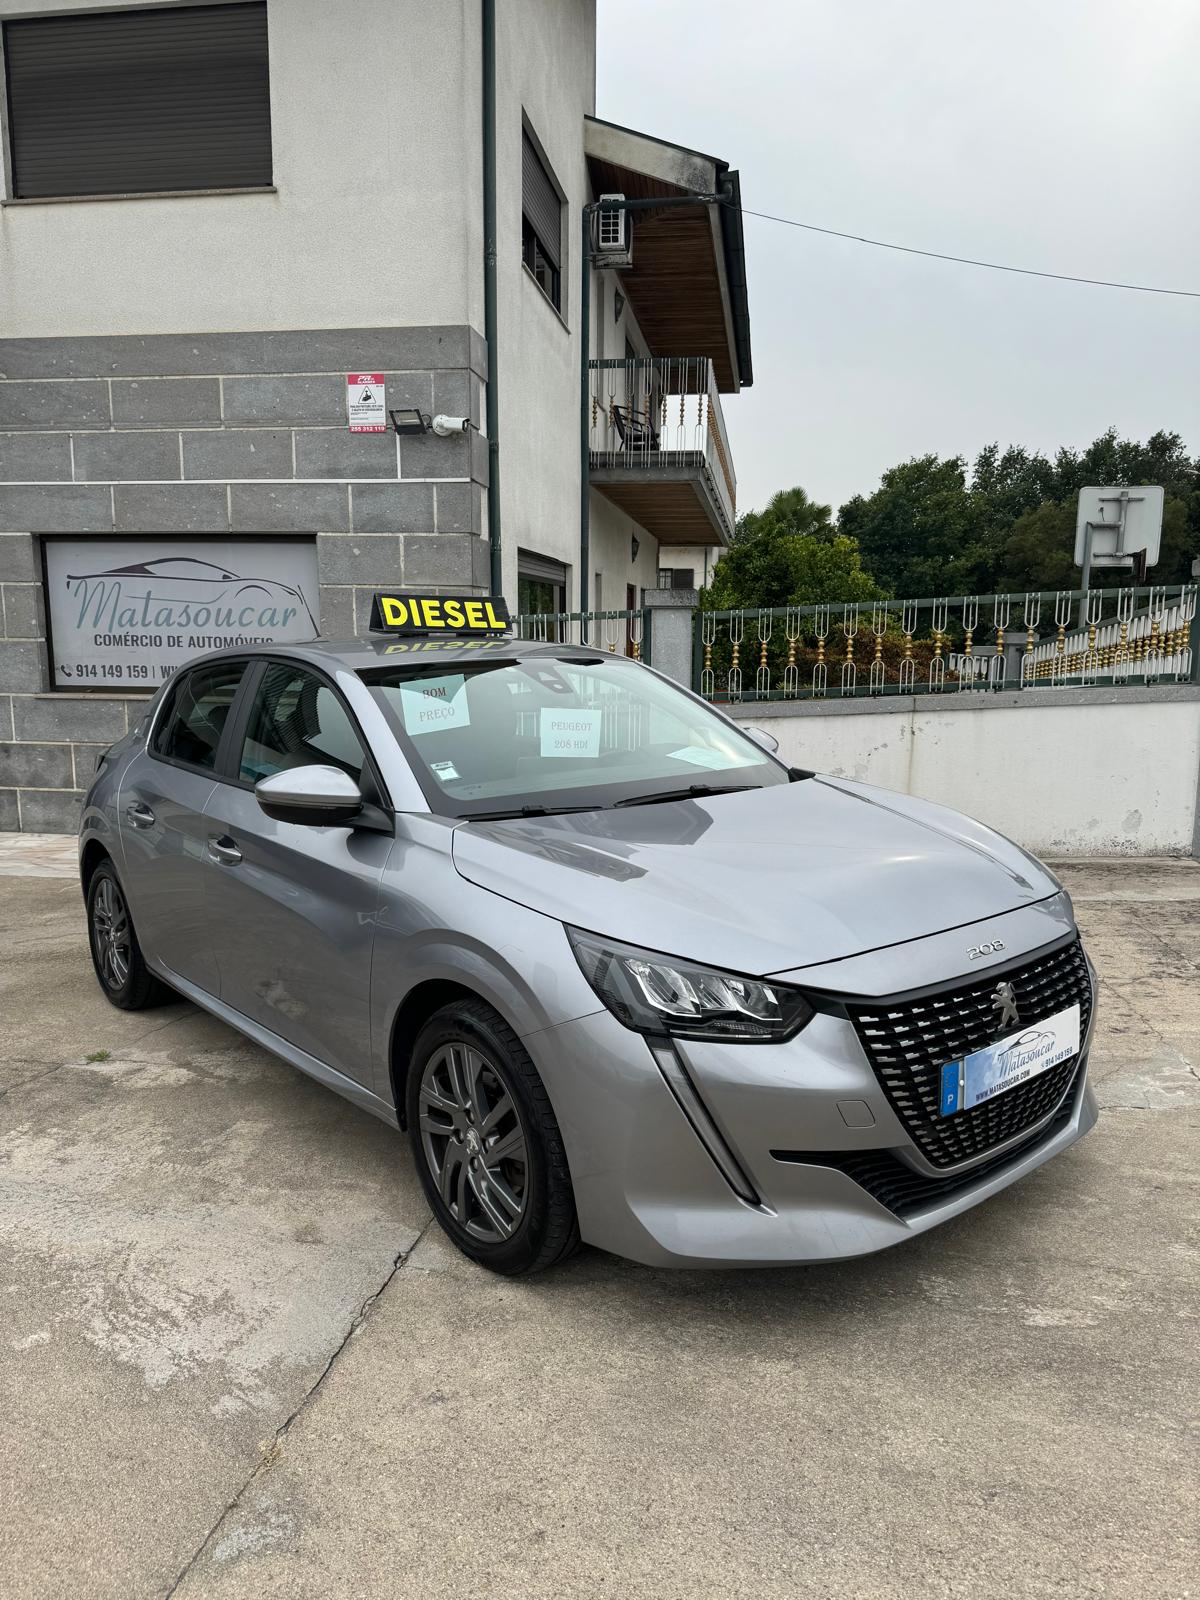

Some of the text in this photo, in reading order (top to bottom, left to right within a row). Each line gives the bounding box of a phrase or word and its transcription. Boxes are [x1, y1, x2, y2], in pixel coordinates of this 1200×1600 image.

[74, 580, 297, 633] Matasoucar
[381, 597, 506, 628] DIESEL
[94, 632, 163, 648] COMÉRCIO
[167, 635, 184, 648] DE
[76, 664, 98, 678] 914
[101, 665, 123, 678] 149
[126, 665, 148, 679] 159
[422, 686, 447, 699] BOM
[420, 707, 455, 722] PREÇO
[551, 721, 593, 731] PEUGEOT
[966, 940, 1006, 960] 208
[997, 1041, 1055, 1078] Matasoucar
[976, 1069, 1031, 1101] WWW.MATASOUCAR.COM
[947, 1094, 954, 1105] P
